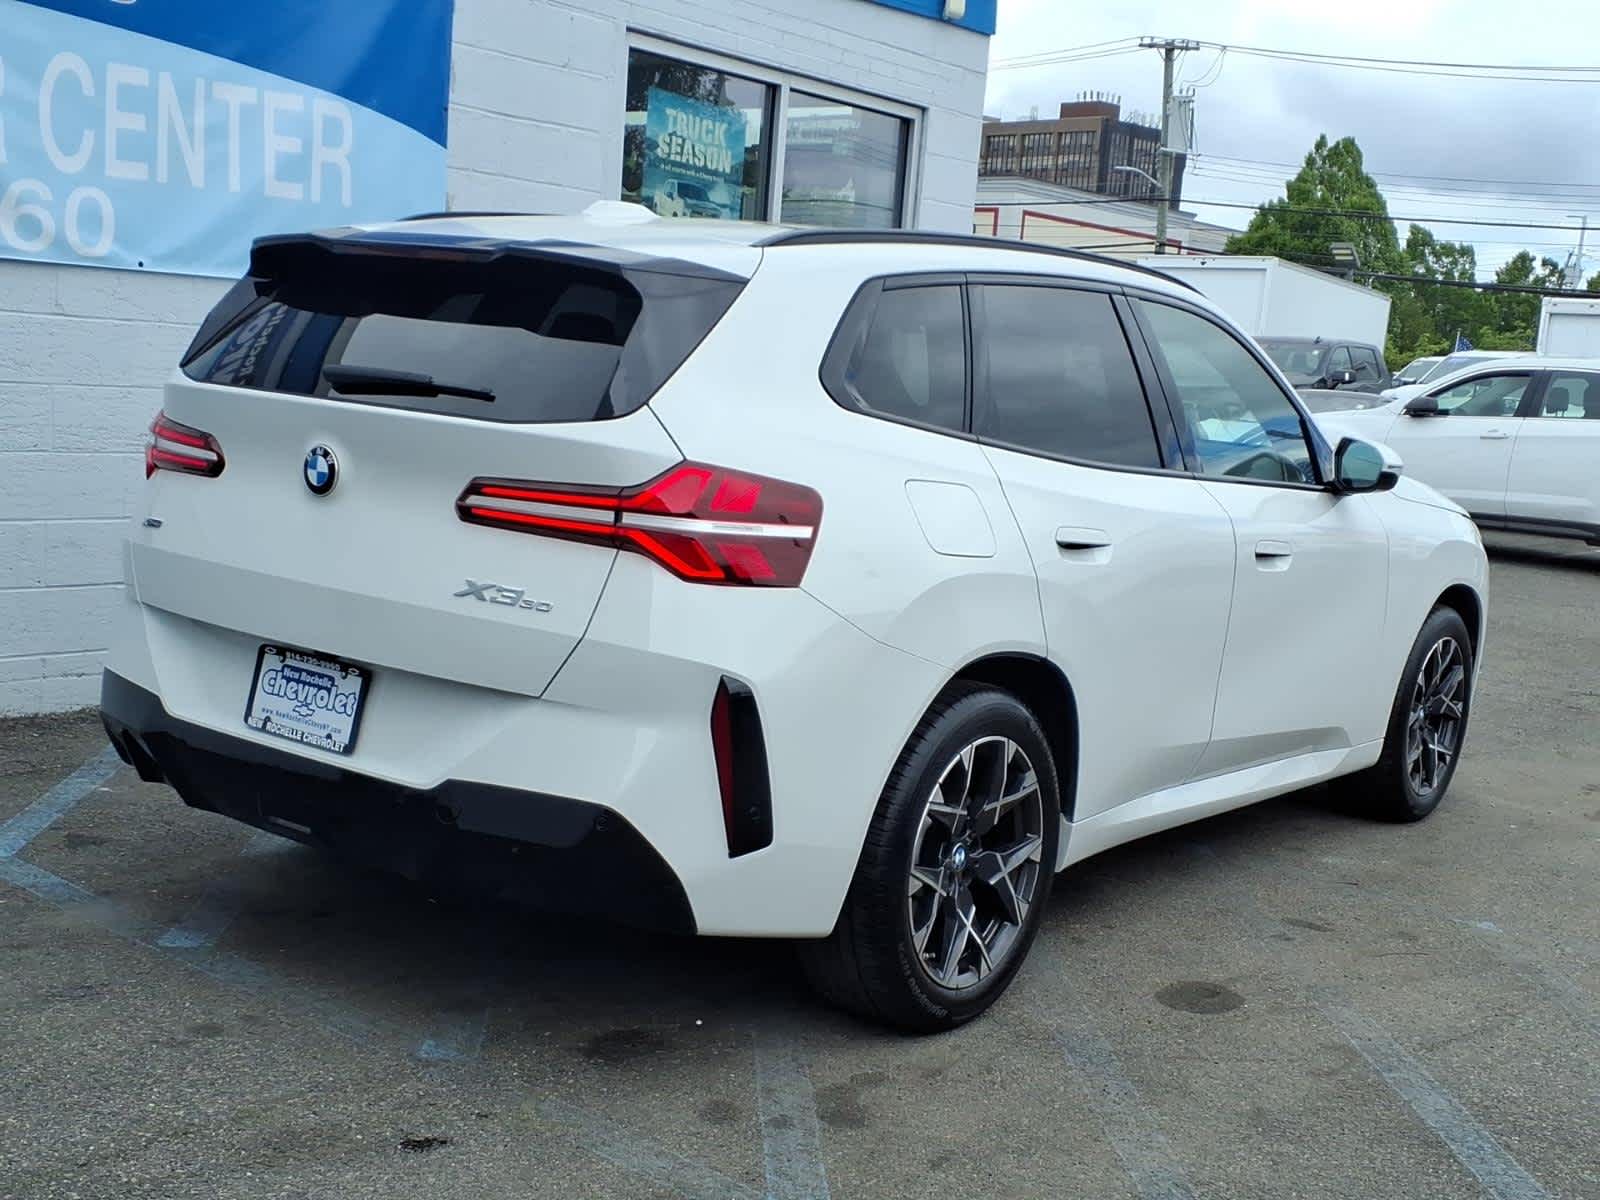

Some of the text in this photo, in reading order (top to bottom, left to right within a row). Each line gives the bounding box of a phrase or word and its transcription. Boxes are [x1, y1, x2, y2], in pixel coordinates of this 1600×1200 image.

[38, 51, 353, 208] CENTER
[665, 107, 729, 149] TRUCK
[656, 132, 732, 174] SEASON
[2, 178, 116, 258] 60
[453, 578, 525, 607] X3
[262, 668, 356, 717] Chevrolet
[283, 666, 333, 688] New Rochelle
[247, 716, 345, 753] NEW ROCHELLE CHEVROLET
